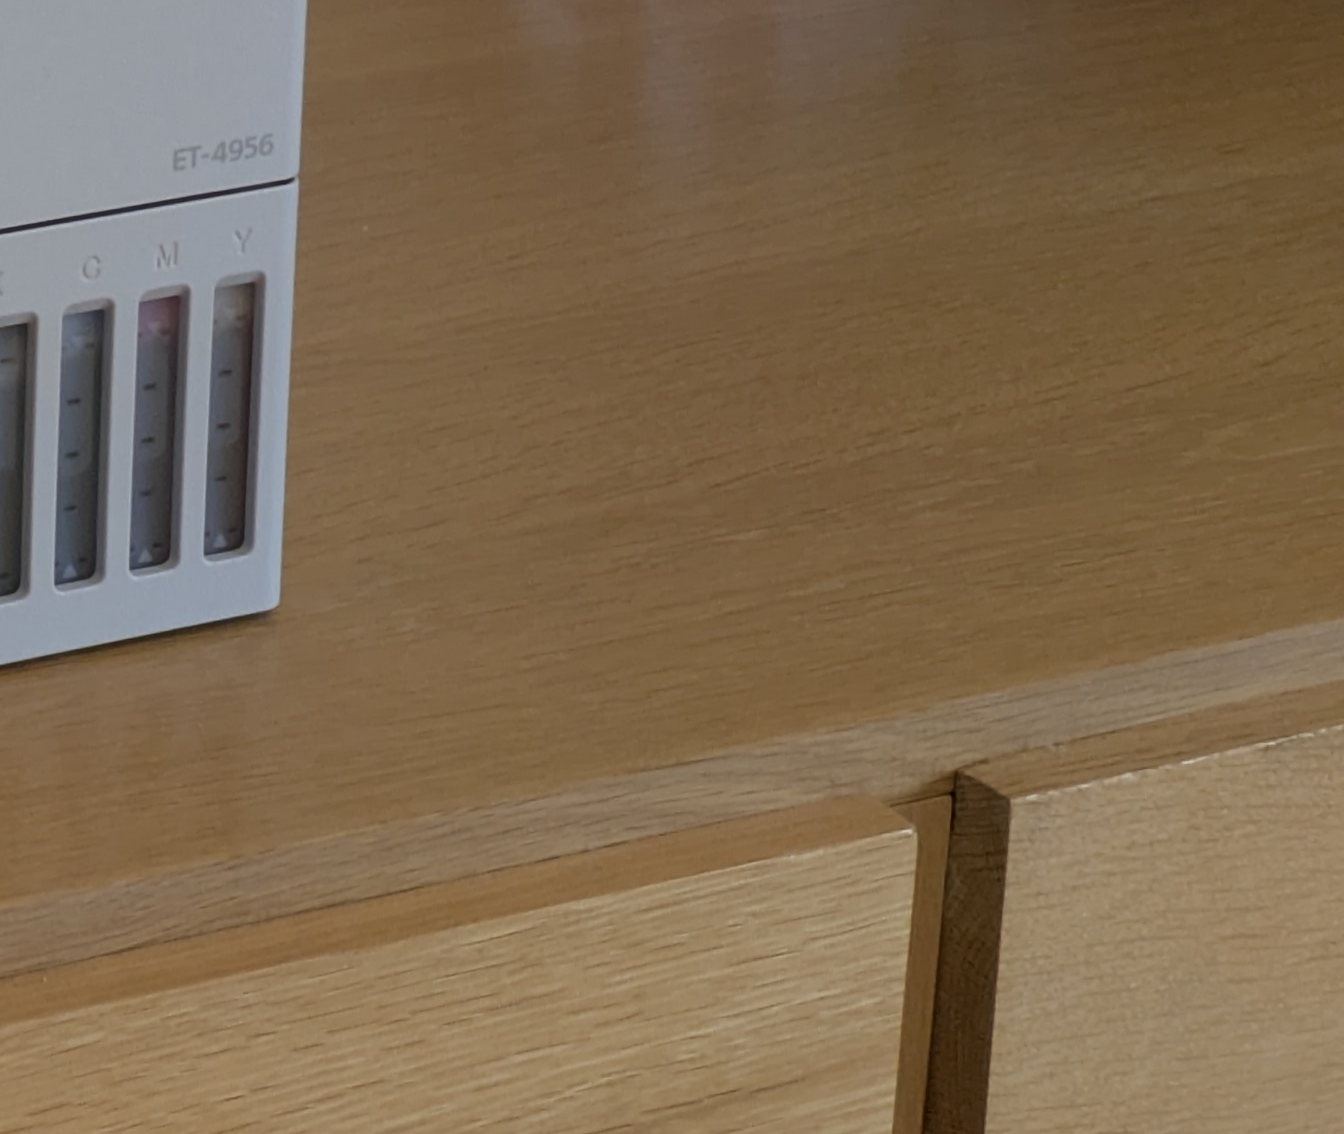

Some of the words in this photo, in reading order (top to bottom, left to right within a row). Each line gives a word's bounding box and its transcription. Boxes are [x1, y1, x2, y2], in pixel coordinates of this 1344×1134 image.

[172, 133, 275, 172] ET-4956
[82, 255, 102, 281] C
[156, 241, 179, 270] M
[235, 227, 254, 254] Y
